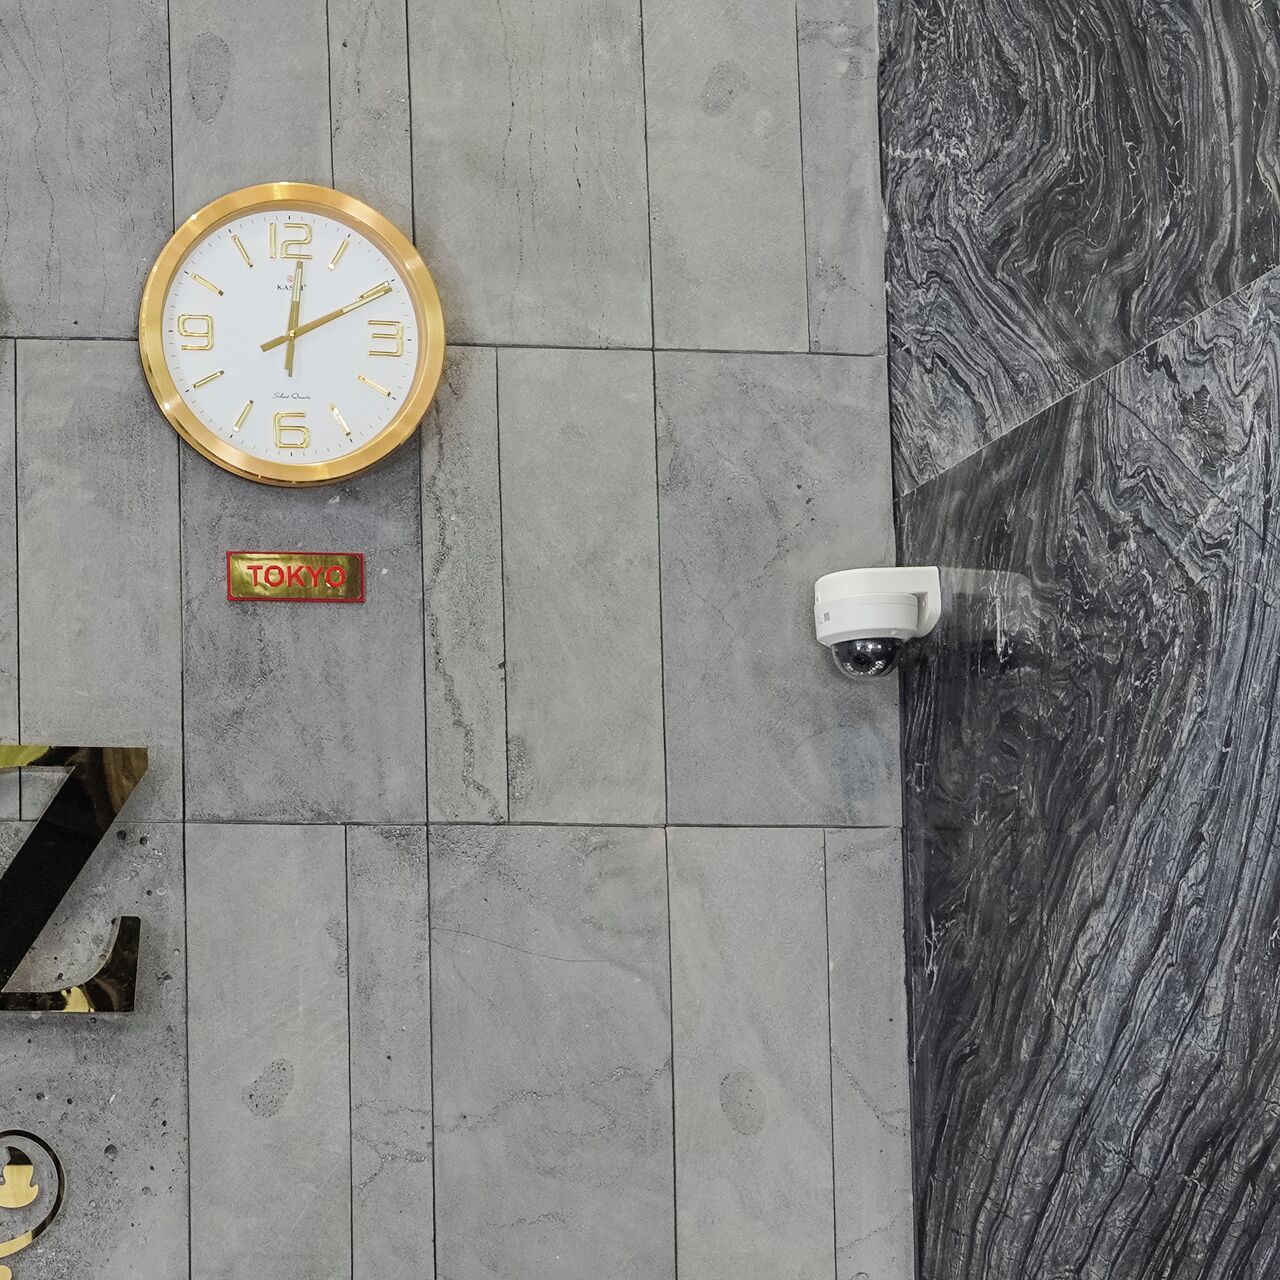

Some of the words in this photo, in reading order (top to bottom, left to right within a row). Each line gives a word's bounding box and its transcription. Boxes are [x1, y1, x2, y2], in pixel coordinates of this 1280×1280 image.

[269, 222, 313, 259] 12
[177, 314, 214, 351] 9
[367, 320, 403, 357] 3
[273, 412, 310, 449] 6
[247, 565, 347, 587] TOKYO
